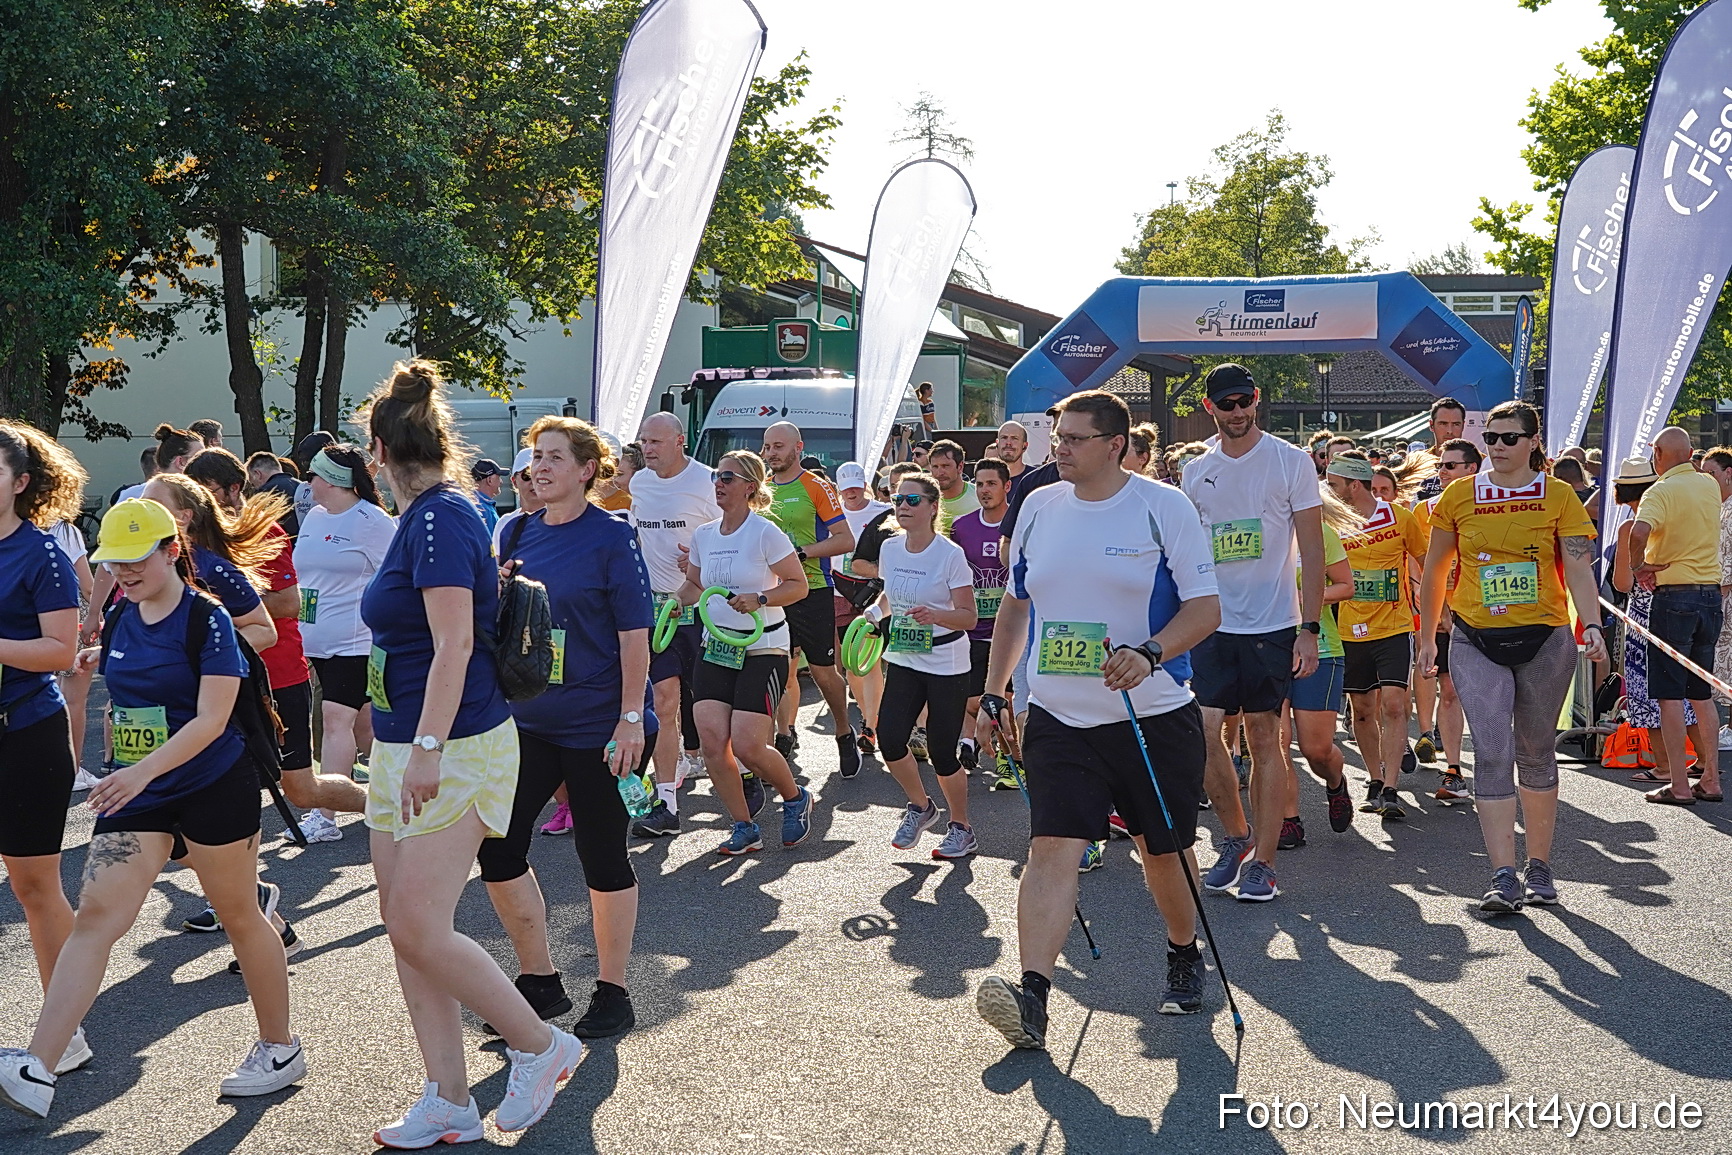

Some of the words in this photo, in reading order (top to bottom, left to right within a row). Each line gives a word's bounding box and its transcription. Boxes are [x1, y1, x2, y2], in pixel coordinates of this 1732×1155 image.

[686, 38, 733, 161] AUTOMOBILE
[1586, 171, 1632, 276] Fischer
[1252, 297, 1282, 305] Fischer
[1230, 311, 1319, 329] firmenlauf
[1060, 342, 1107, 353] Fischer
[1420, 338, 1433, 346] das
[716, 406, 757, 417] abavent
[1474, 506, 1506, 515] MAX
[1510, 502, 1546, 513] BÖGL
[662, 519, 686, 528] Team
[1219, 533, 1252, 550] 1147
[1367, 529, 1400, 546] BÖGL
[1377, 582, 1385, 598] 2022
[1490, 577, 1529, 593] 1148
[976, 598, 1001, 609] 1576
[895, 629, 925, 642] 1505
[710, 640, 738, 656] 1504
[1041, 642, 1049, 668] WALK
[1053, 640, 1087, 658] 312
[1049, 659, 1074, 667] Hornung
[1075, 659, 1091, 667] Jörg
[1094, 644, 1102, 669] 2022
[119, 728, 155, 748] 1279
